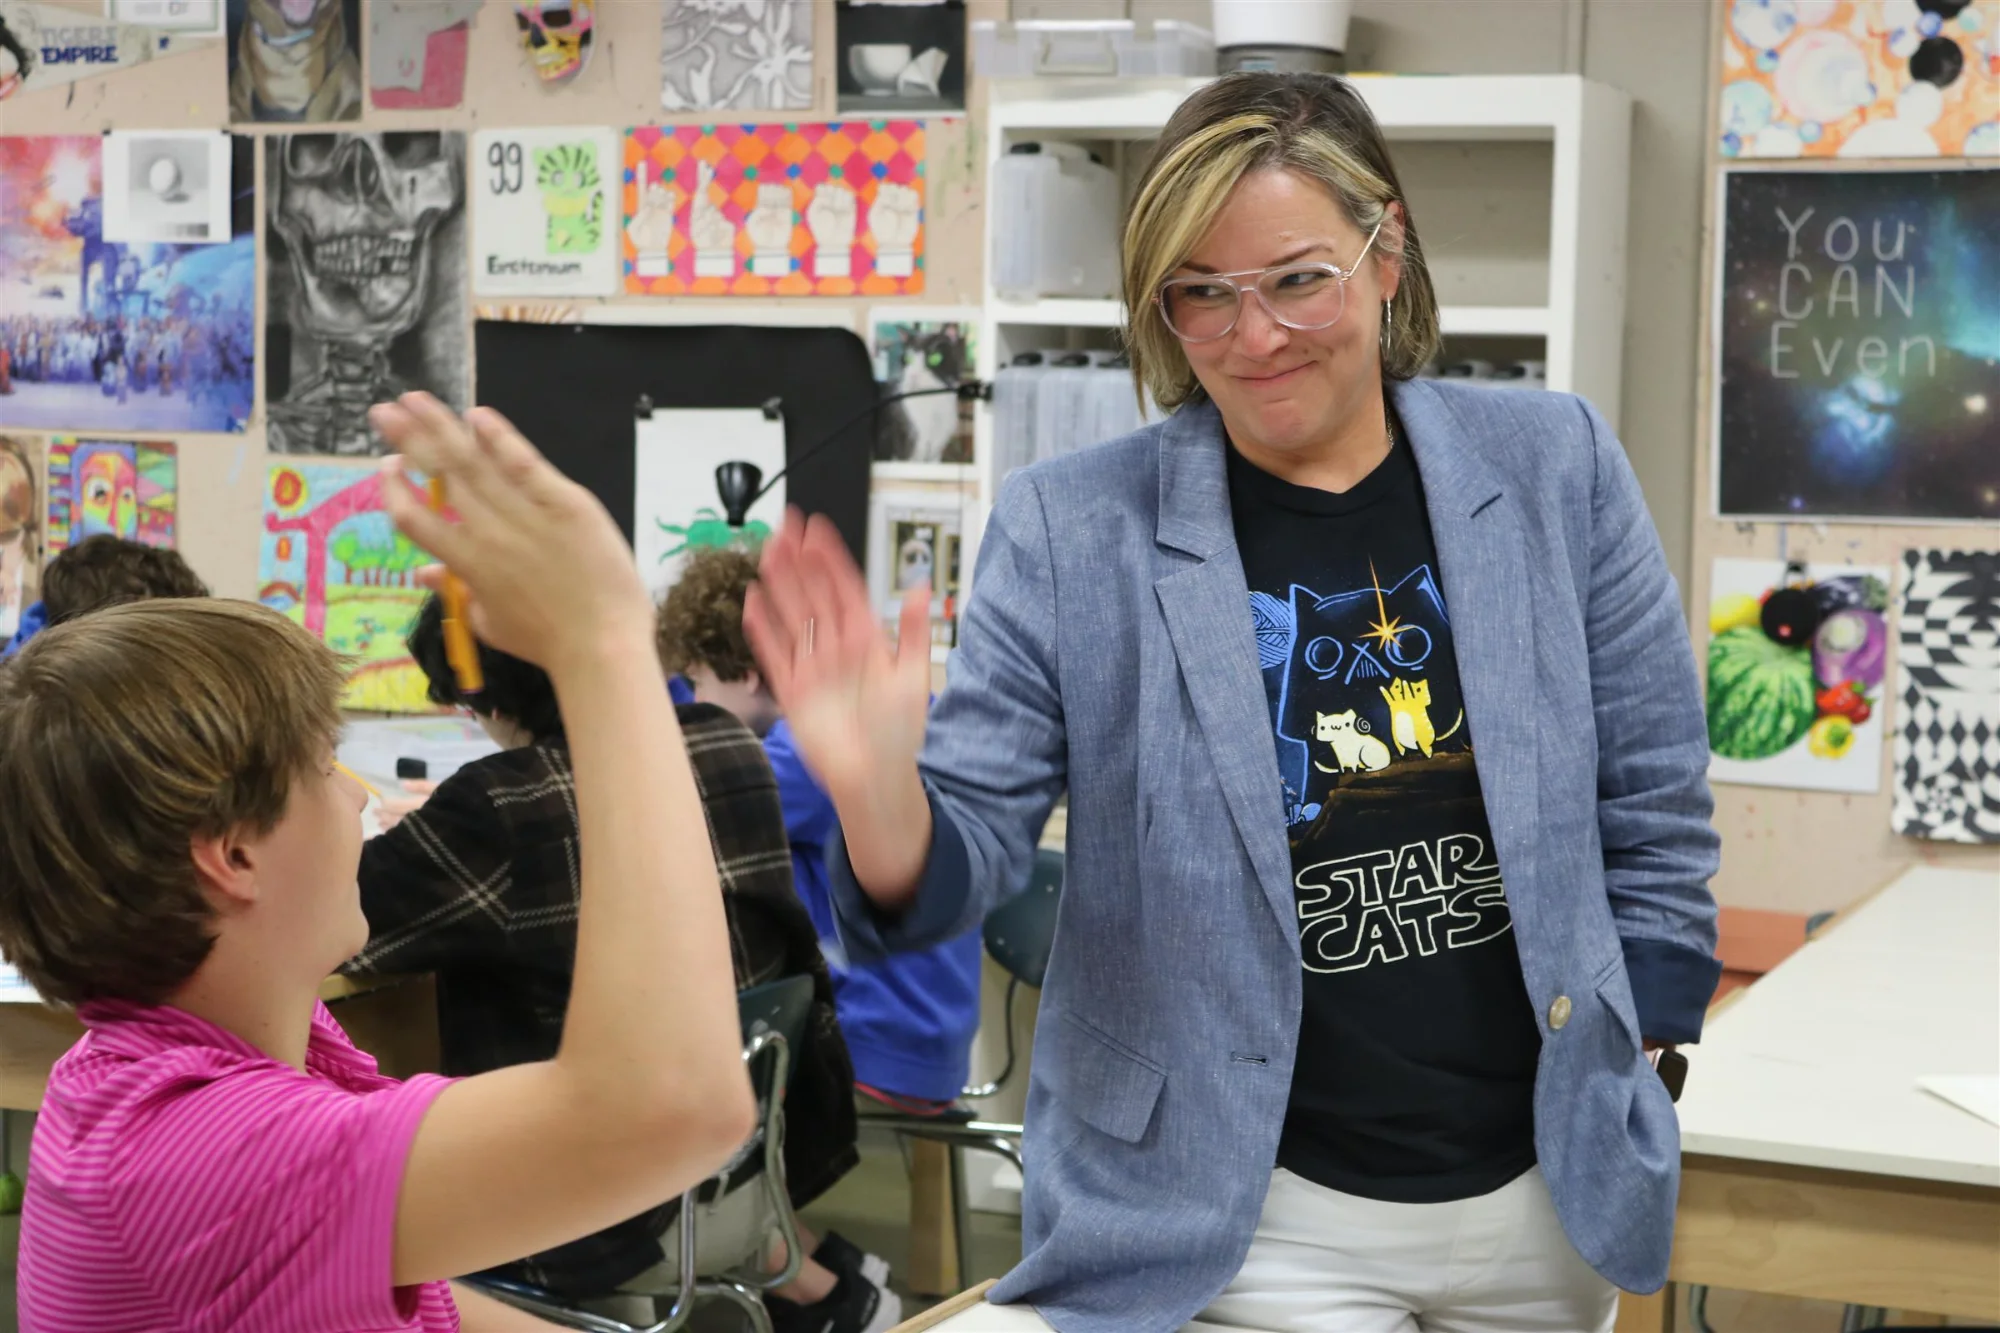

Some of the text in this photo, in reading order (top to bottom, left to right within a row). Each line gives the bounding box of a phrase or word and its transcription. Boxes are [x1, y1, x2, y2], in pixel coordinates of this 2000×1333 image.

[40, 46, 118, 64] EMPIRE
[488, 142, 523, 195] 99
[1778, 261, 1915, 320] CAN
[1770, 321, 1936, 378] Even
[1296, 833, 1501, 919] STAR
[1300, 883, 1512, 974] CATS
